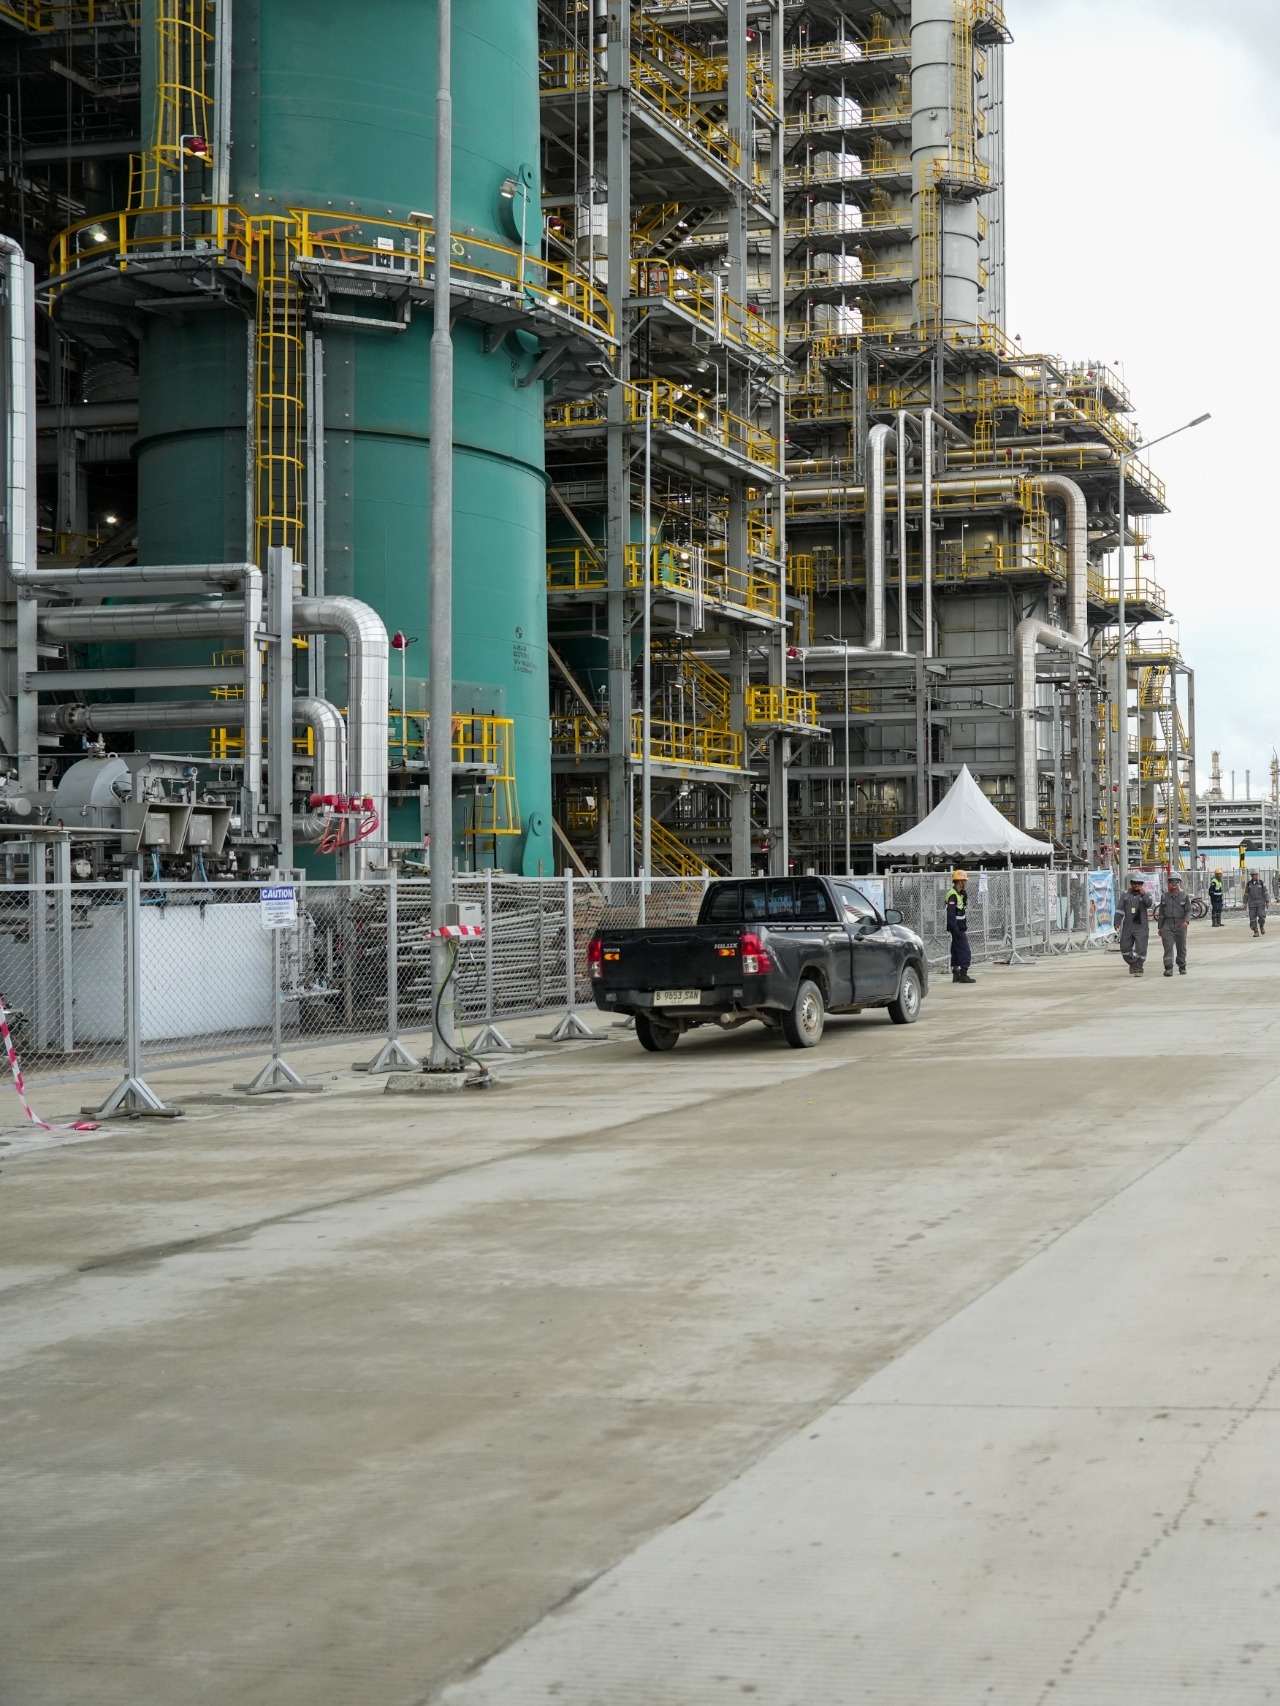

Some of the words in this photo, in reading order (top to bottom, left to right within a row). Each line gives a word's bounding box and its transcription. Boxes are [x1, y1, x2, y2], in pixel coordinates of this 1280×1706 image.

[262, 889, 292, 899] CAUTION
[656, 992, 661, 1001] B
[684, 991, 699, 1000] SAN
